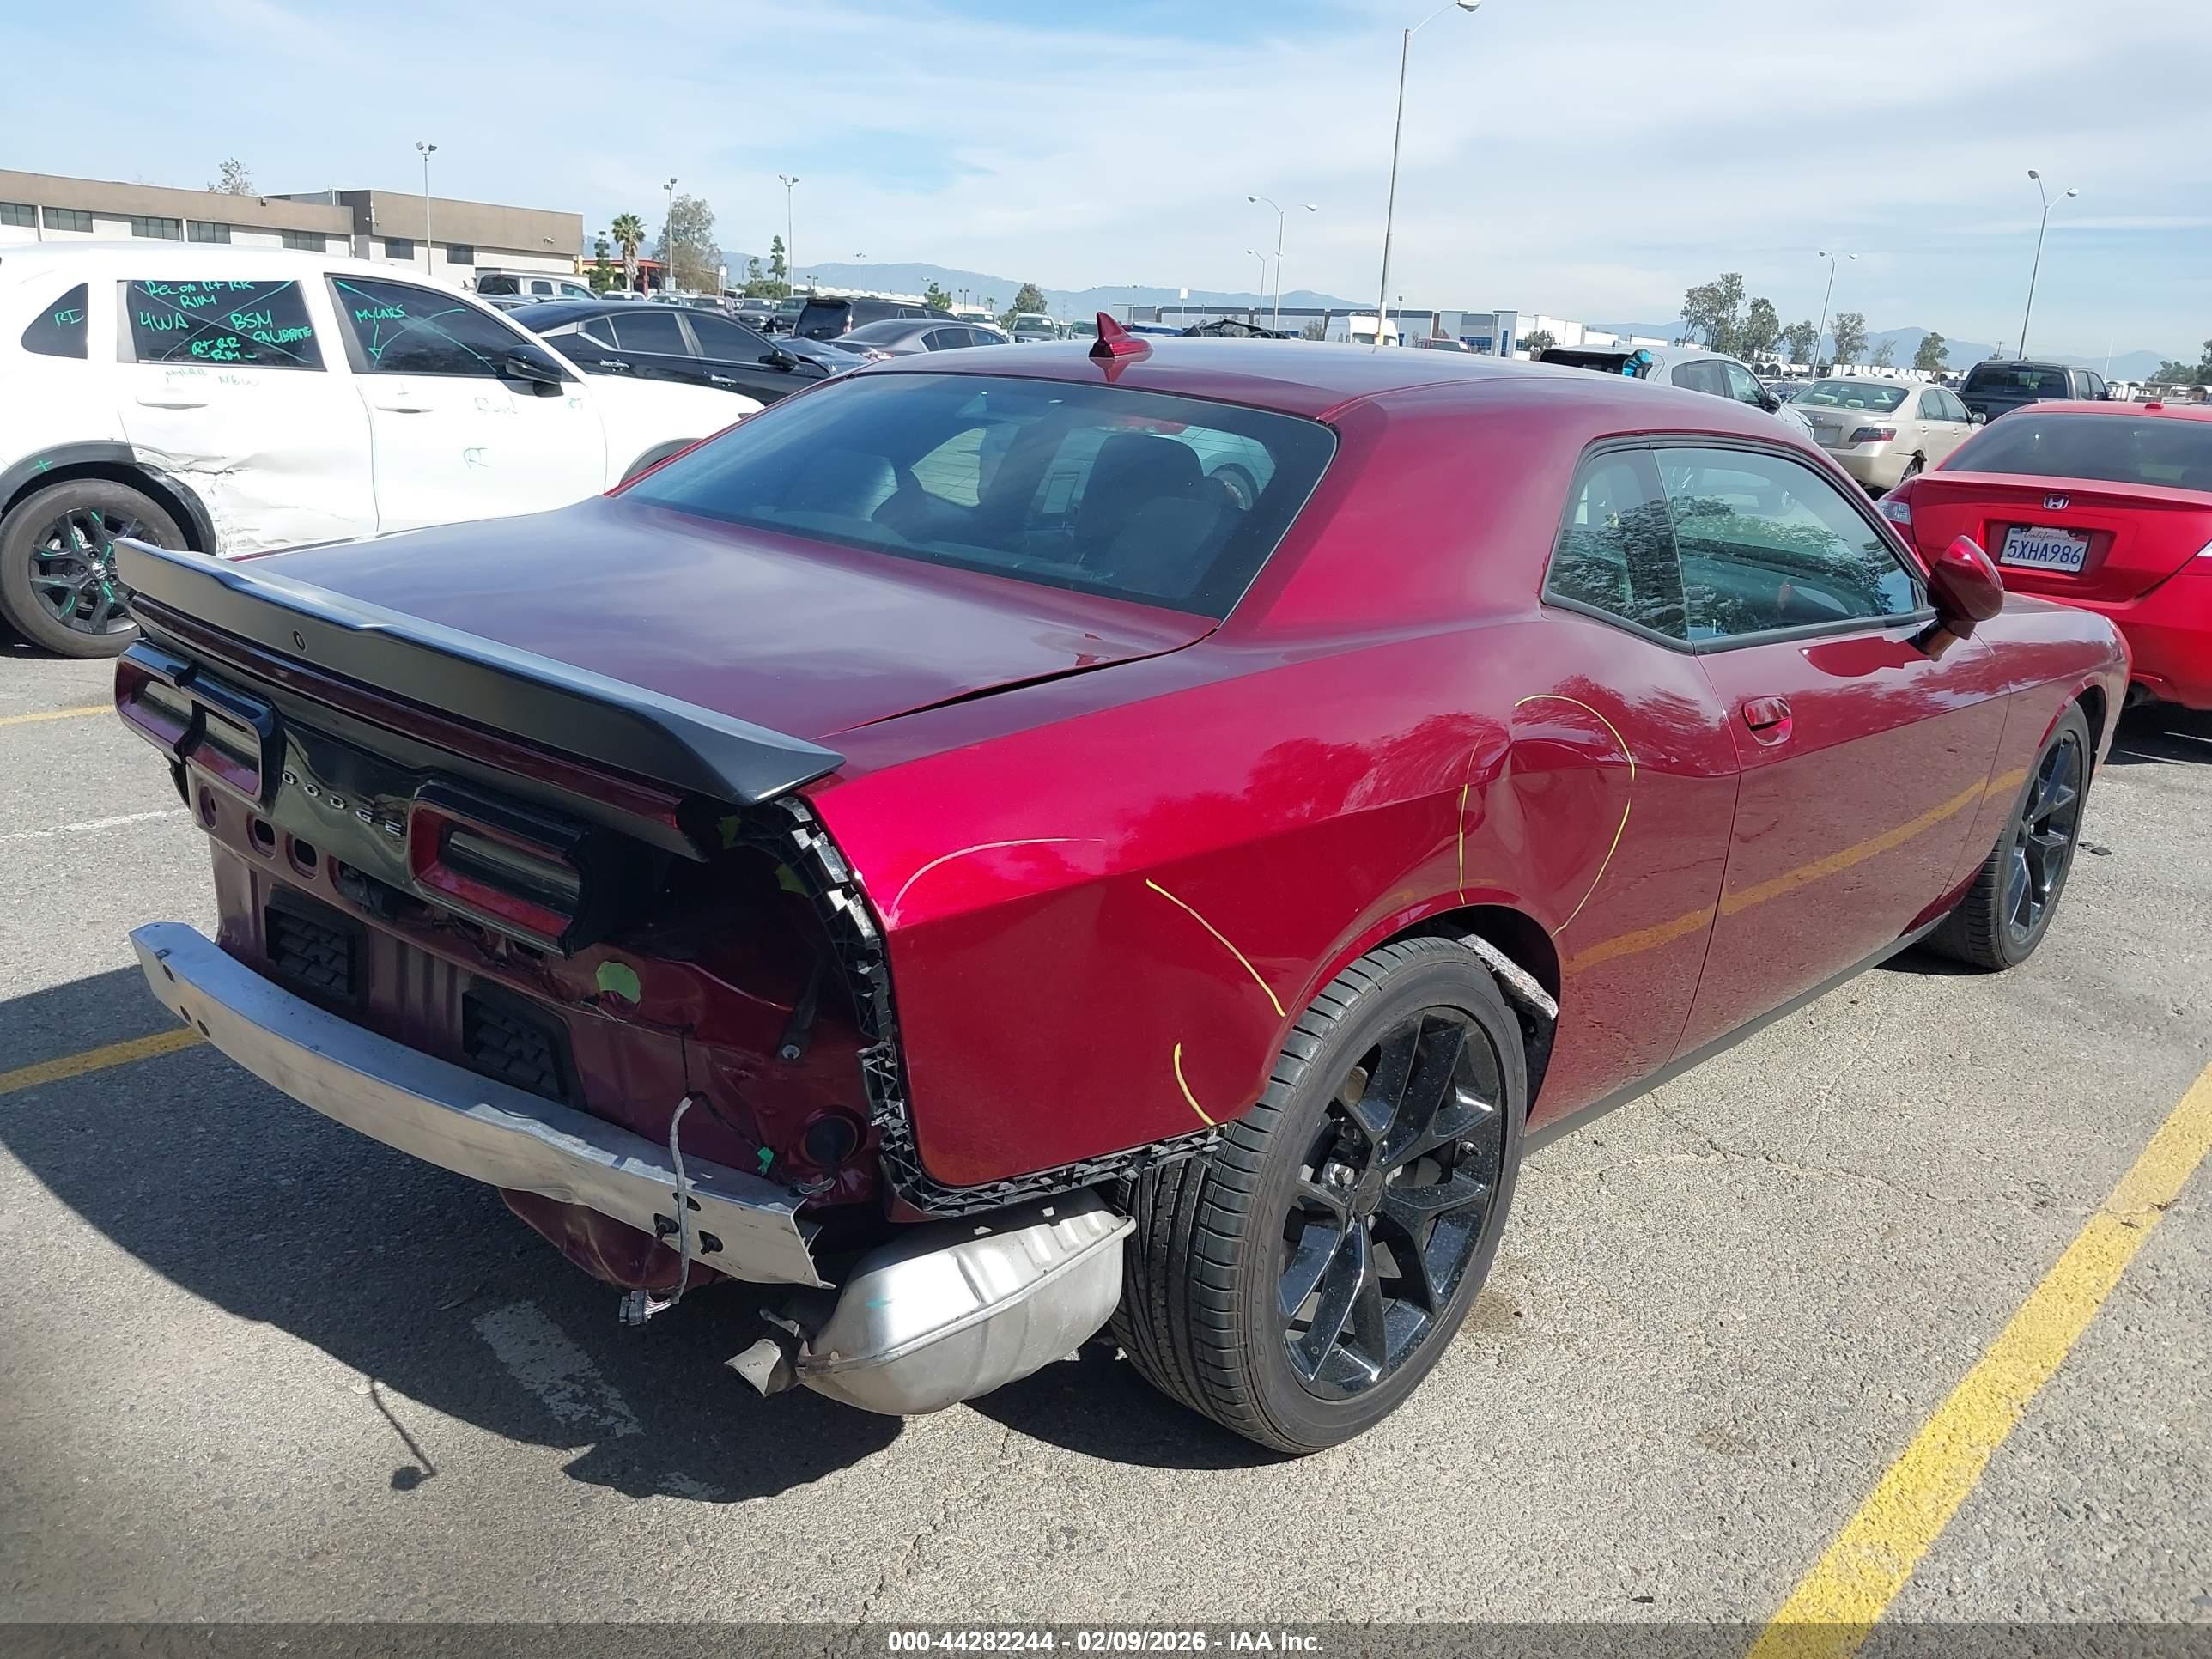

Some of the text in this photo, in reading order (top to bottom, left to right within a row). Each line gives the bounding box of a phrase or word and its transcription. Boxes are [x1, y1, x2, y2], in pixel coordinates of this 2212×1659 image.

[179, 295, 217, 309] RIM
[139, 311, 189, 332] 4WA
[230, 310, 274, 331] BSM
[2008, 539, 2083, 565] 5XHA986
[283, 770, 404, 836] DODGE
